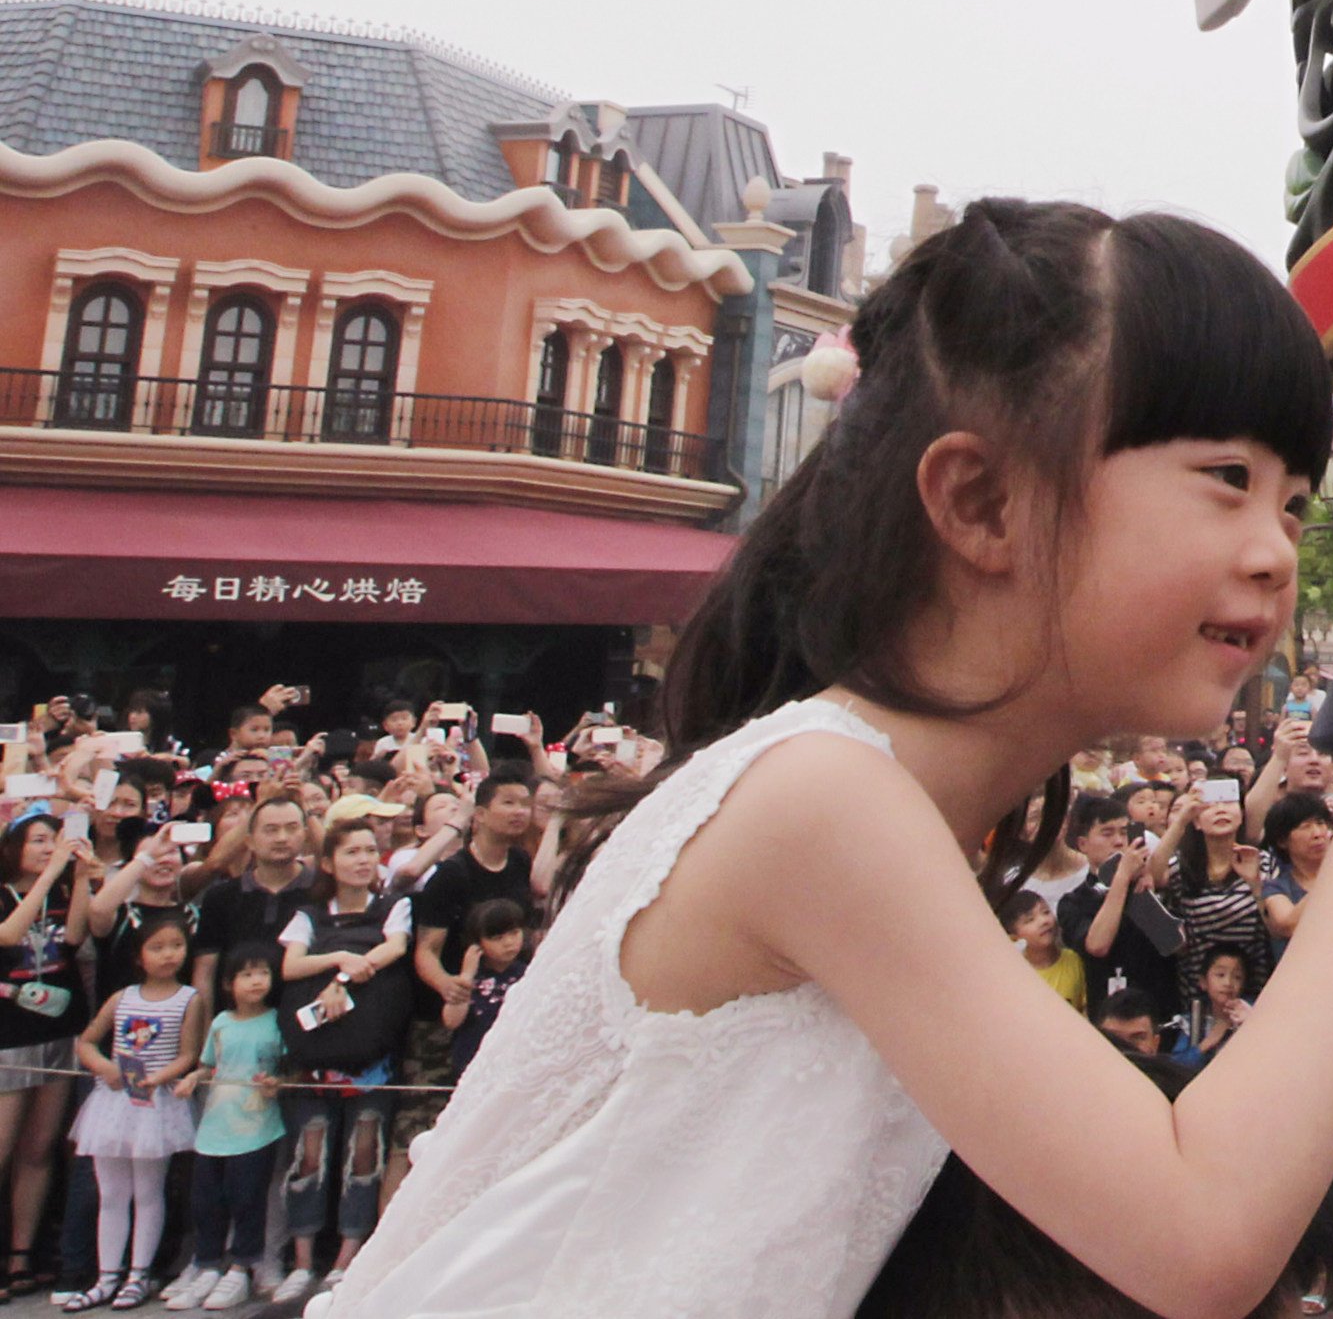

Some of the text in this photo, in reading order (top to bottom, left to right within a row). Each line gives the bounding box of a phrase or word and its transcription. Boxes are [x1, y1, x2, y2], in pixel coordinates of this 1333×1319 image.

[161, 574, 428, 605] 每日精心烘焙
